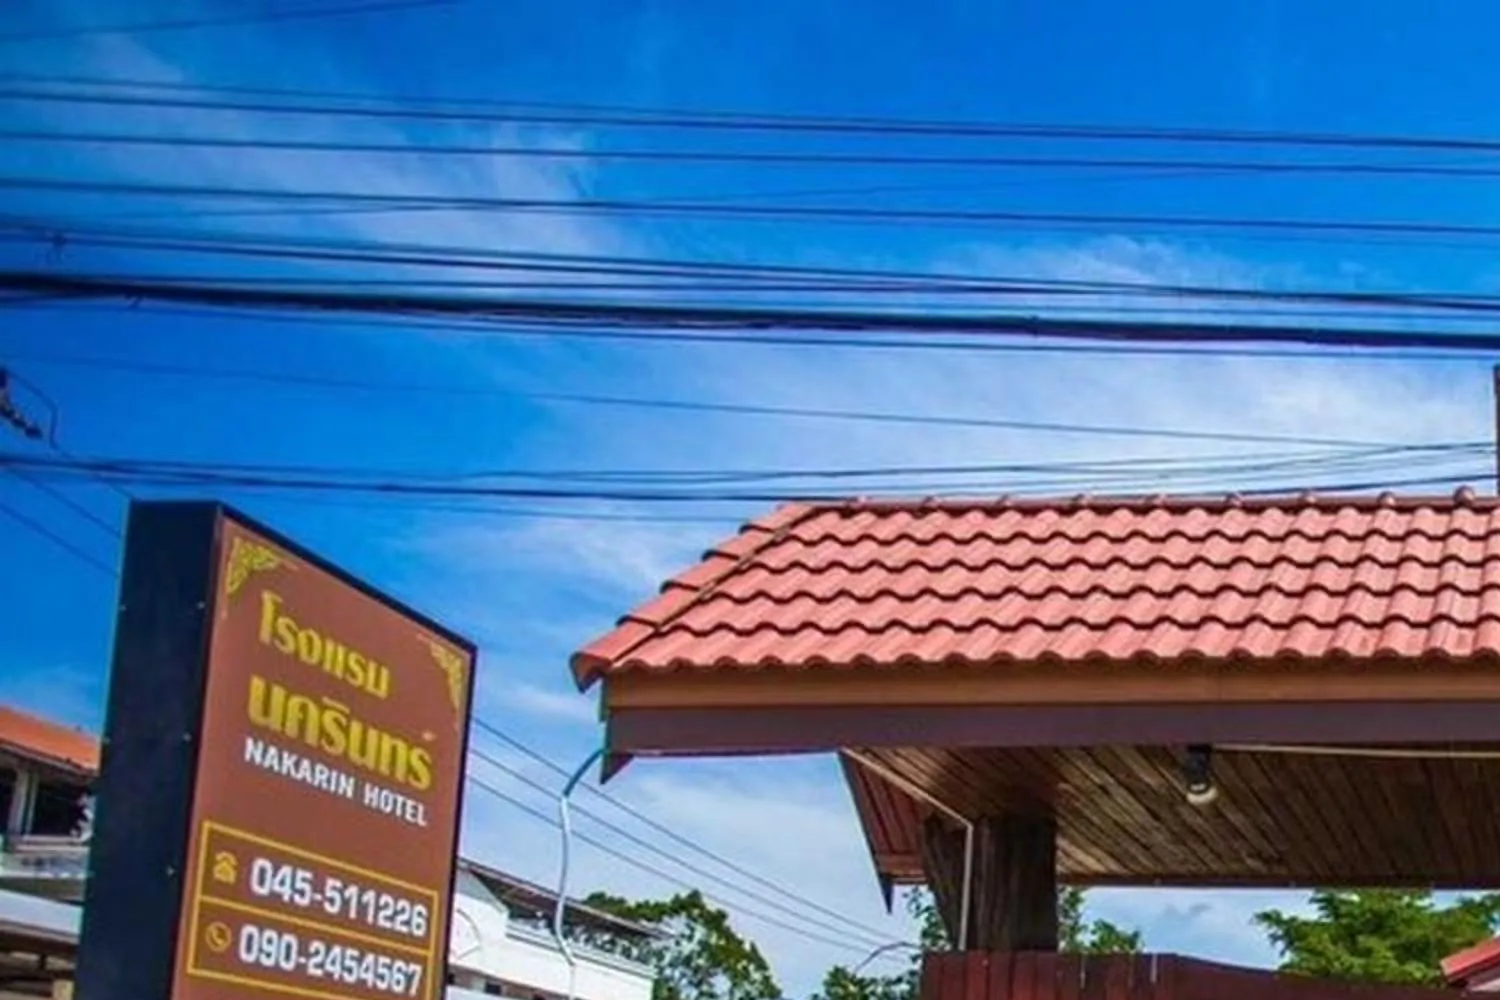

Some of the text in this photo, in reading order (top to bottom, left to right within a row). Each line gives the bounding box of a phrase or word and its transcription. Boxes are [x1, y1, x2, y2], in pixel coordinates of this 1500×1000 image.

[259, 589, 390, 699] โรงแรม
[247, 675, 436, 791] นครินทร์
[244, 736, 428, 827] NAKARIN HOTEL
[250, 857, 429, 937] 045-511226
[238, 924, 423, 997] 090-2454567
